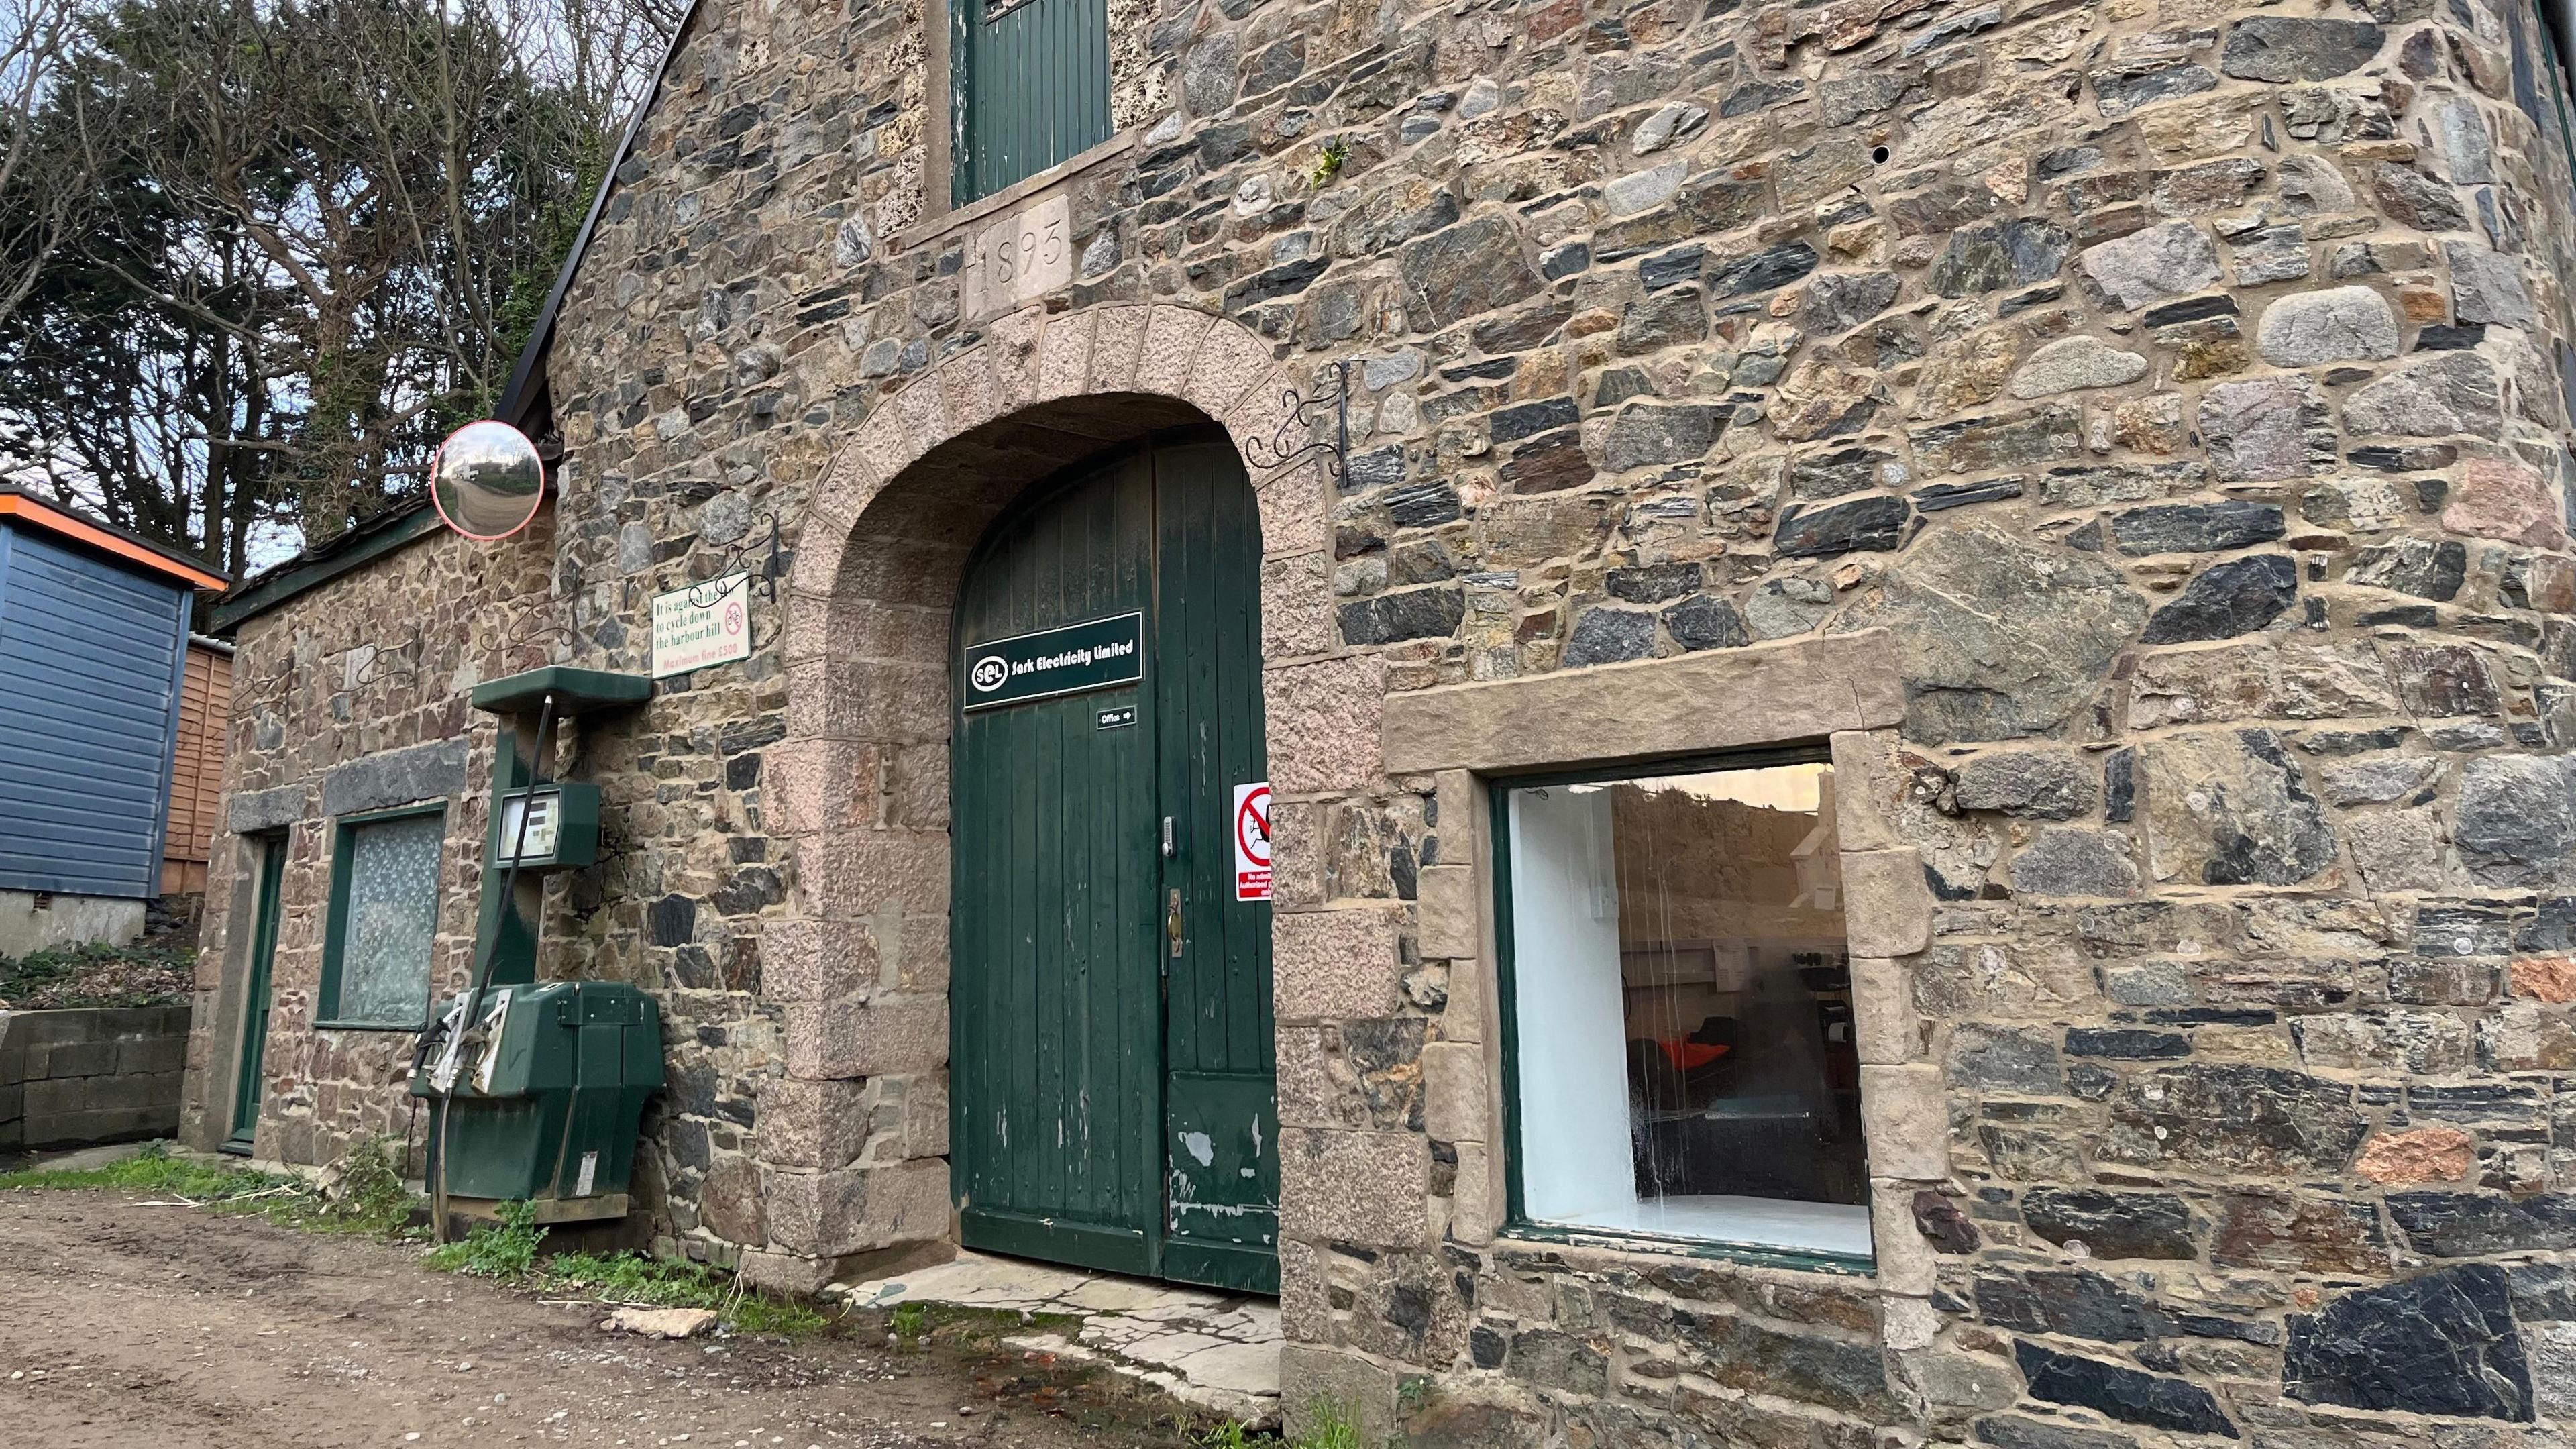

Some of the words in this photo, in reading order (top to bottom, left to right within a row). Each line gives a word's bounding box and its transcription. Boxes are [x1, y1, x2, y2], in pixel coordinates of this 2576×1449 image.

[973, 219, 1062, 297] 1893
[657, 604, 663, 616] It
[665, 602, 672, 614] is
[674, 594, 702, 612] against
[705, 590, 718, 602] the
[656, 623, 664, 633] to
[666, 615, 687, 631] cycle
[689, 610, 711, 625] down
[656, 636, 669, 650] the
[671, 629, 704, 646] harbour
[706, 622, 720, 638] hill
[664, 655, 700, 669] Maximum
[702, 650, 716, 661] fine
[718, 643, 737, 657] £500
[1012, 659, 1034, 676] Sark
[1036, 649, 1091, 671] Electricity
[1093, 639, 1134, 660] Limited
[1101, 714, 1120, 724] Office
[1240, 881, 1267, 889] Authorised
